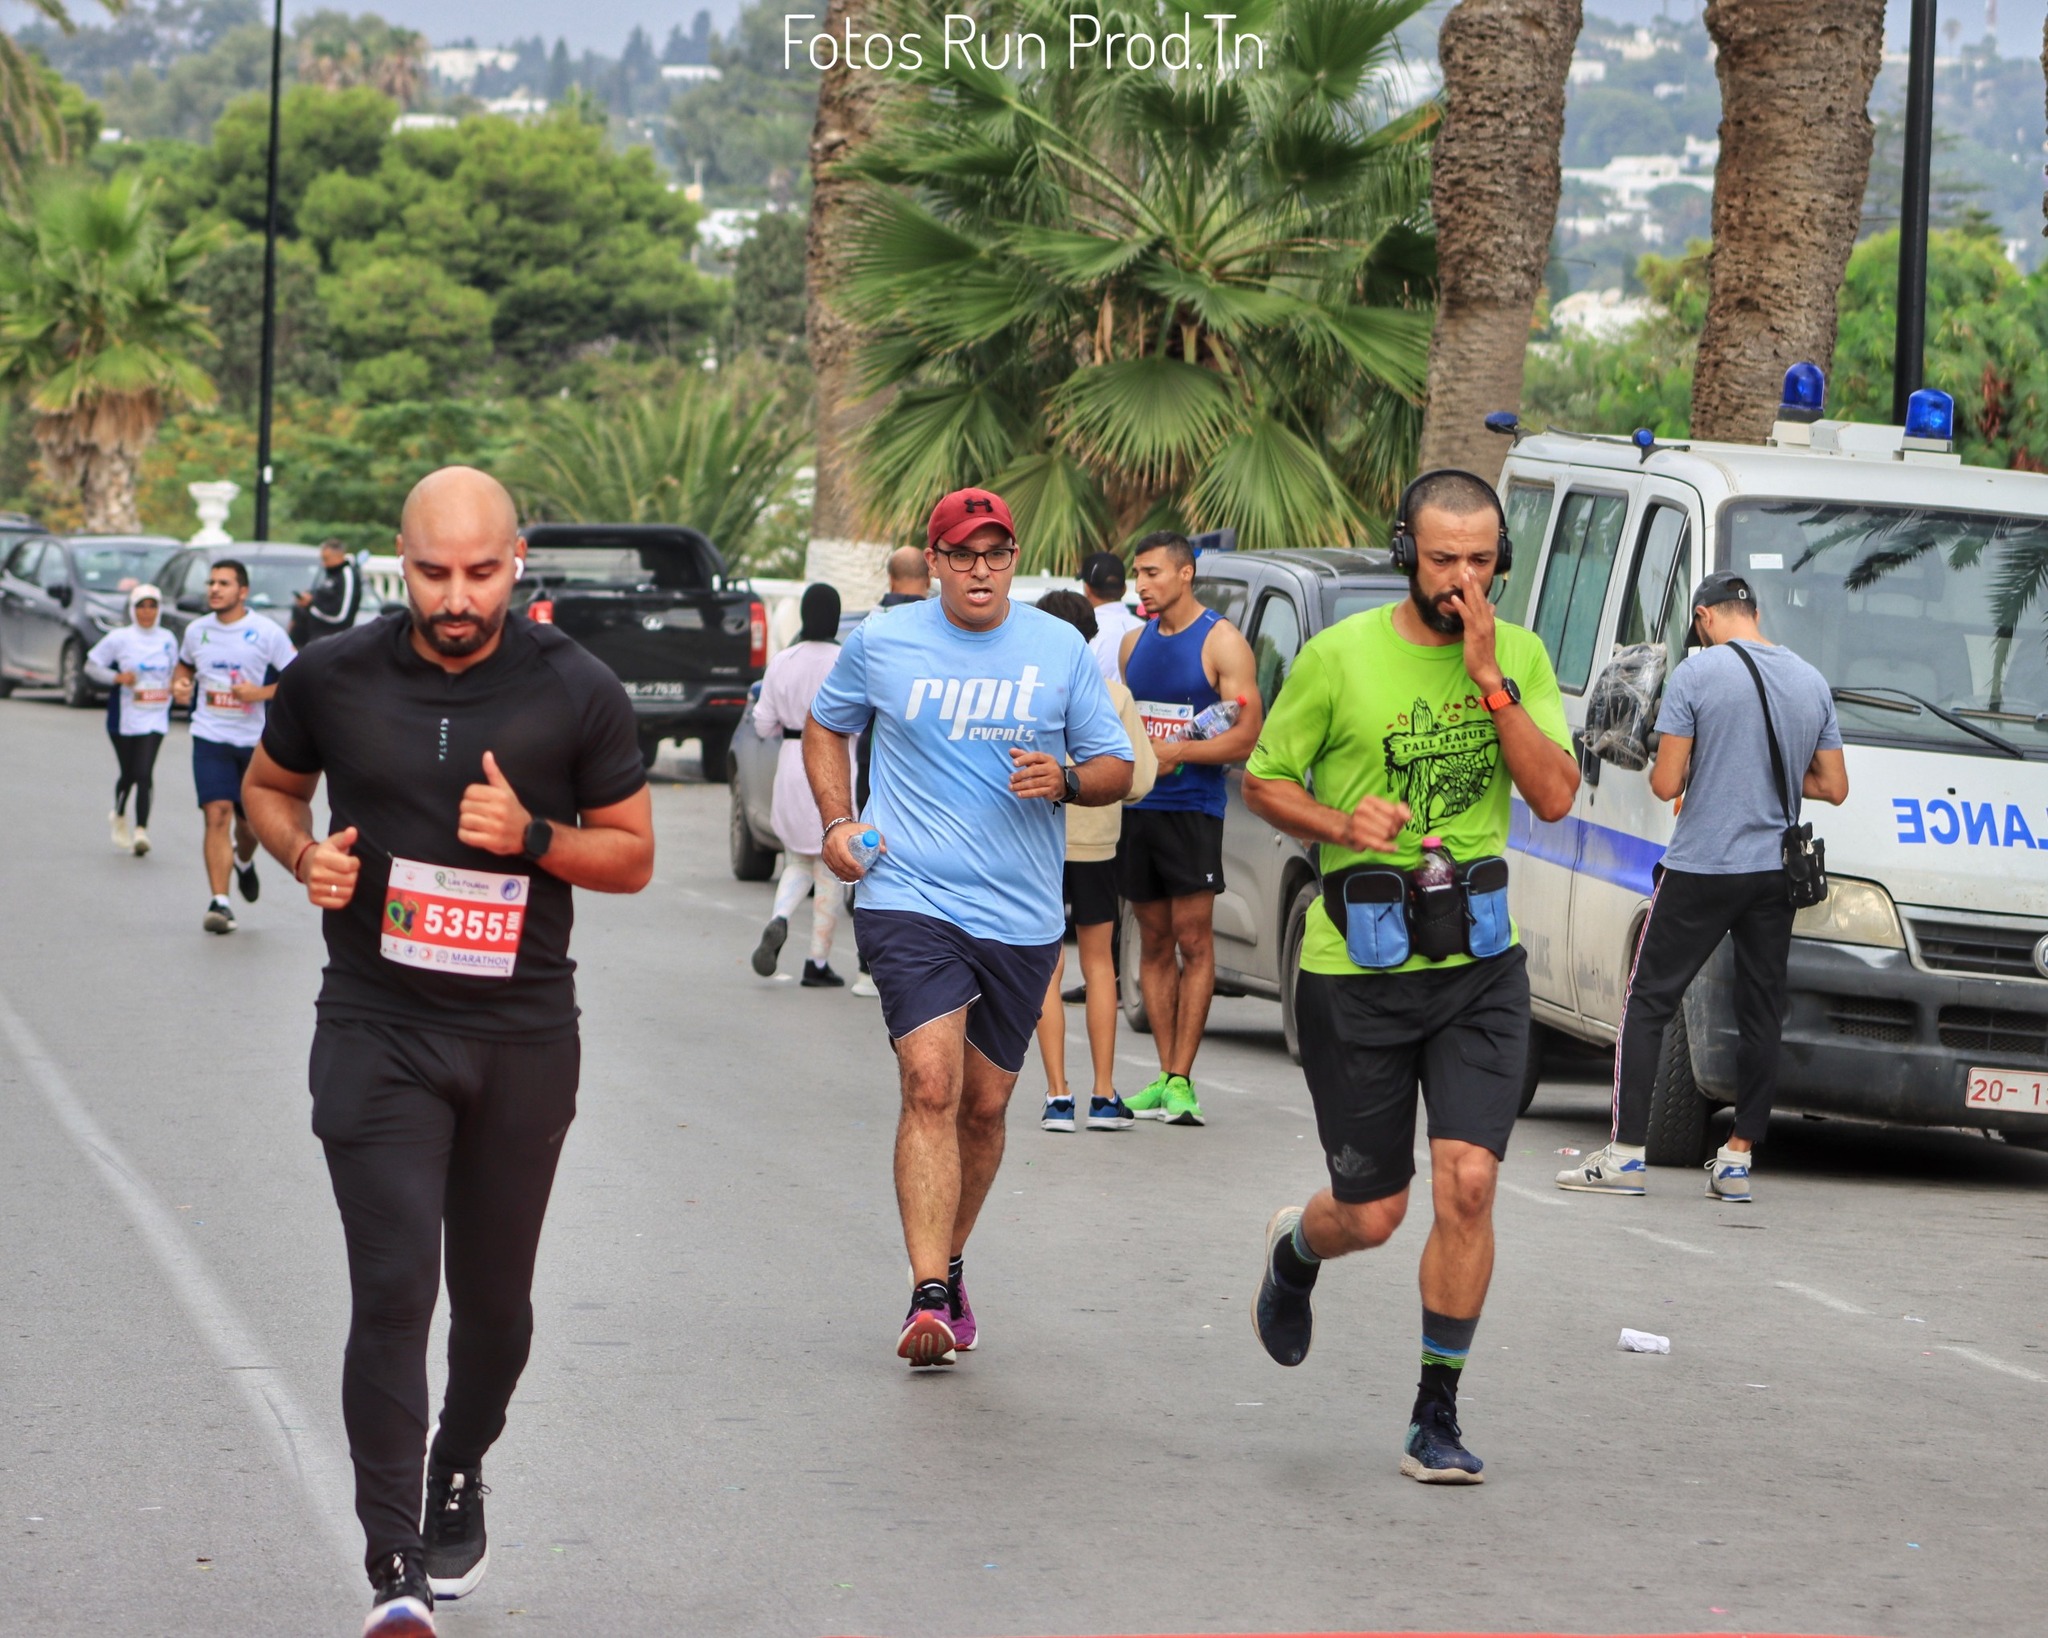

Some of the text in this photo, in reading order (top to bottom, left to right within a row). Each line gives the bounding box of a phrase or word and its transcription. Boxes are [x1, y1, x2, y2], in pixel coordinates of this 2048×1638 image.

[905, 665, 1046, 741] ripit
[968, 724, 1036, 743] events
[1403, 729, 1487, 753] FALL LEAGUE
[424, 903, 505, 942] 5355
[450, 952, 509, 966] MARATHON
[2032, 1083, 2048, 1106] 1
